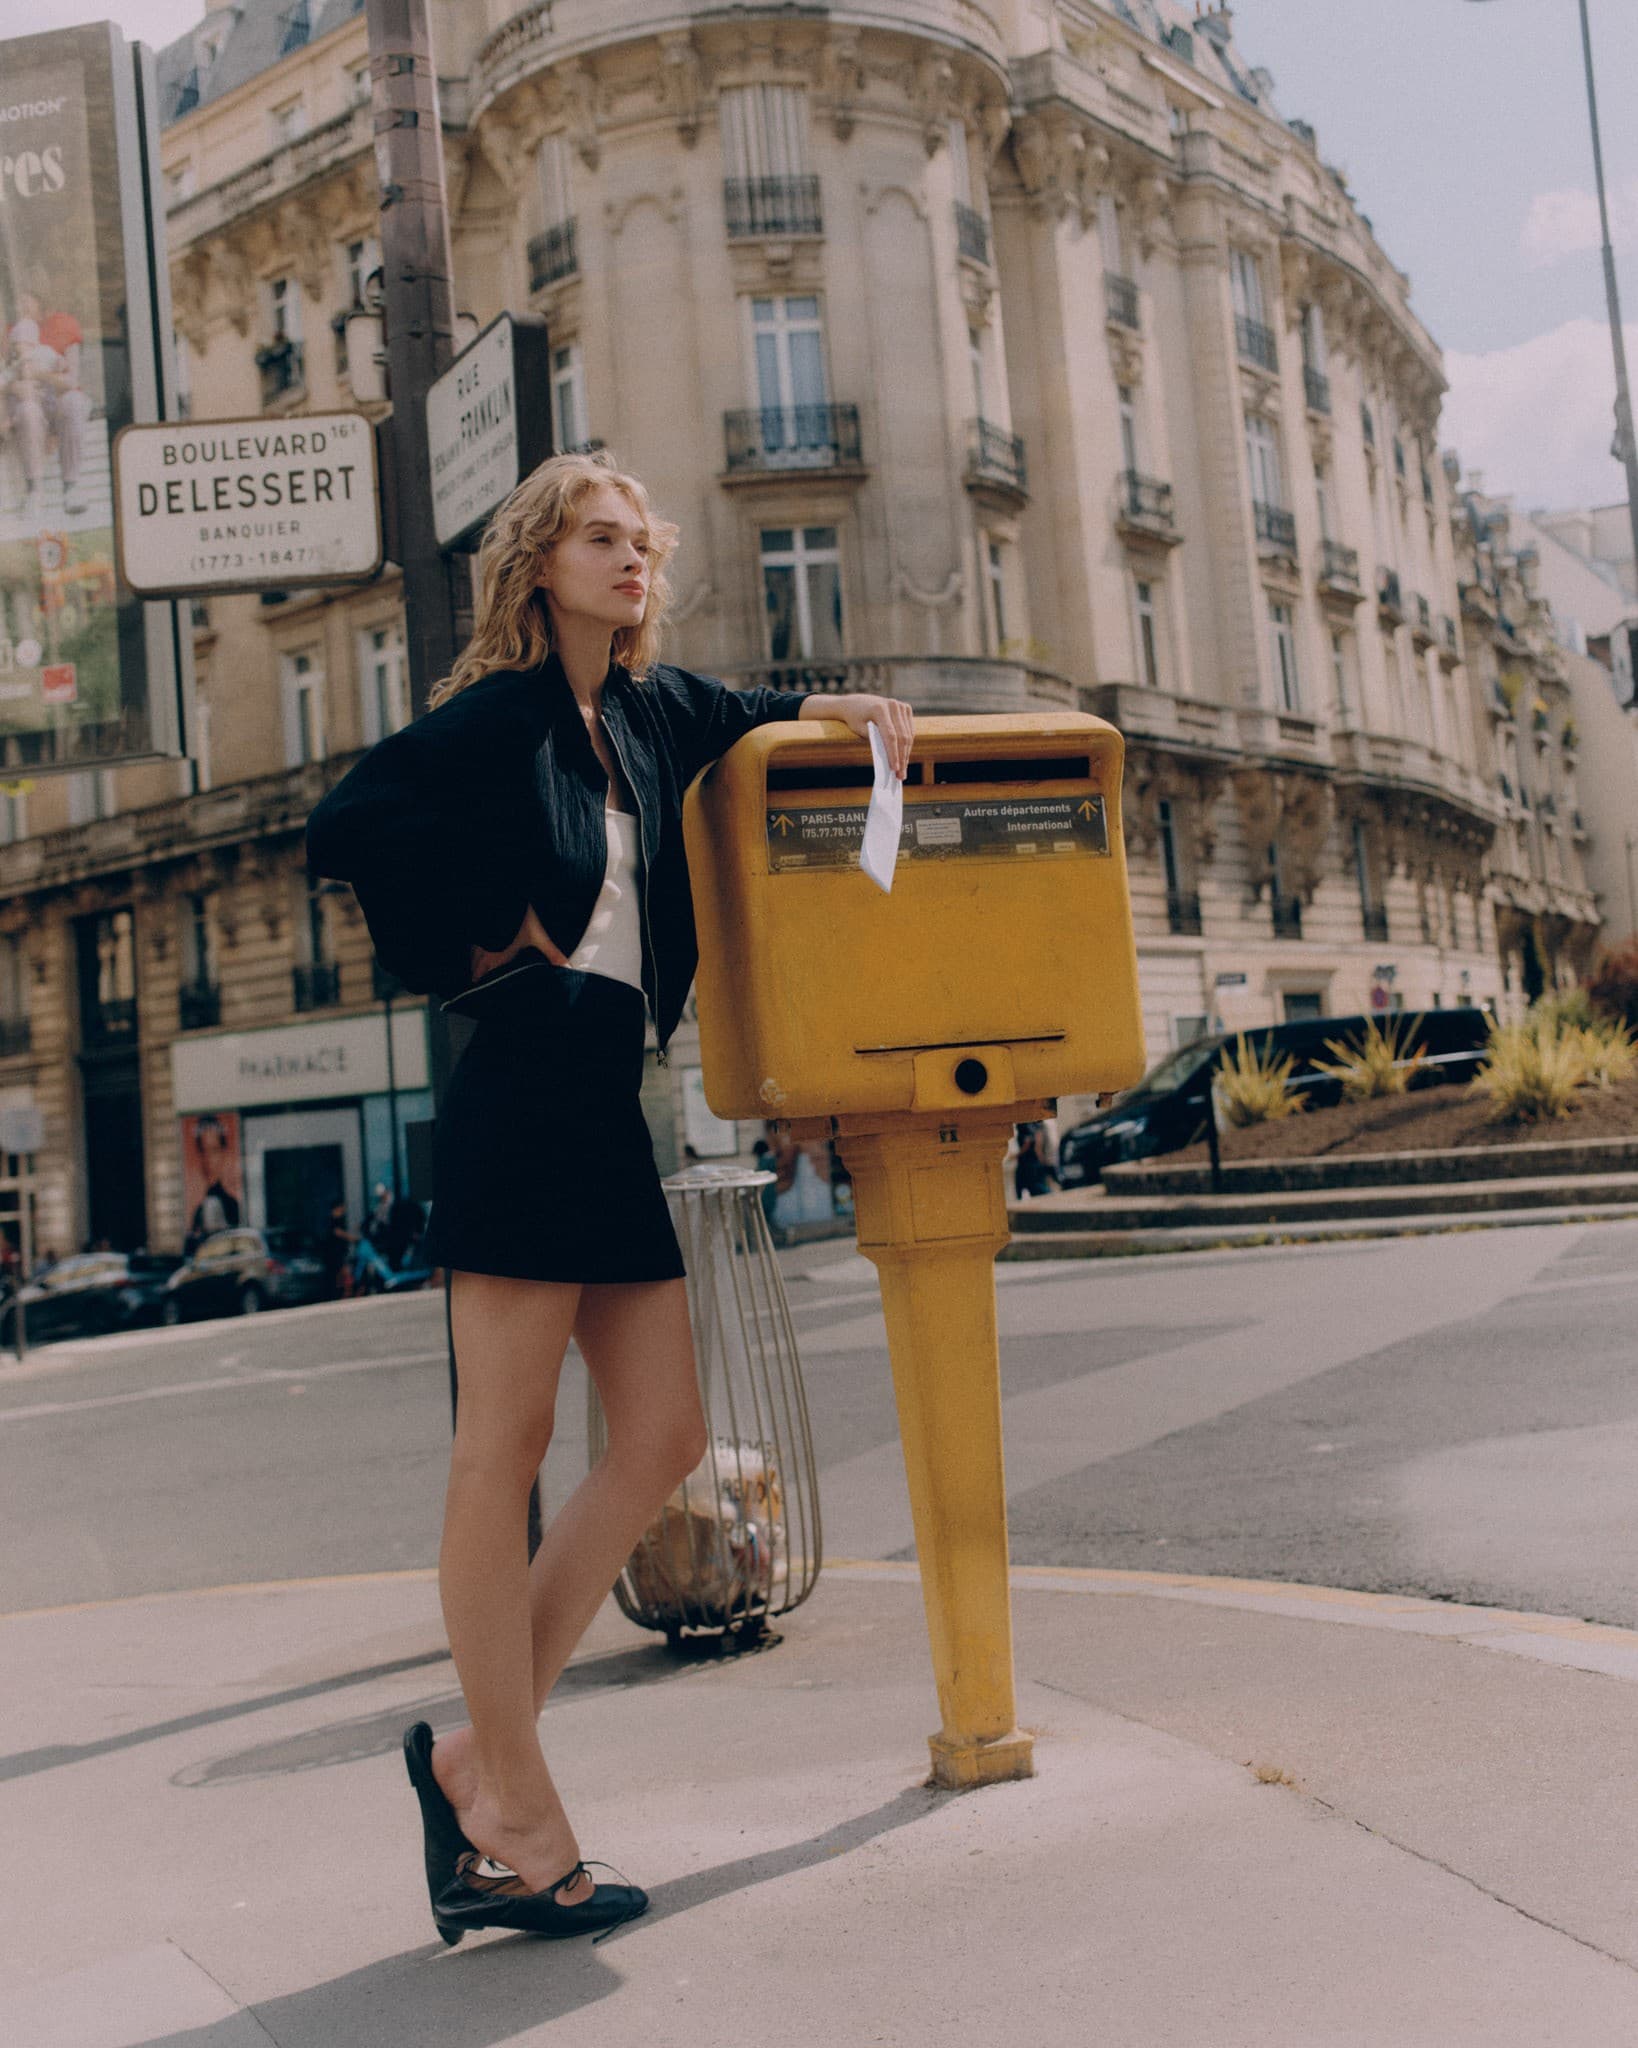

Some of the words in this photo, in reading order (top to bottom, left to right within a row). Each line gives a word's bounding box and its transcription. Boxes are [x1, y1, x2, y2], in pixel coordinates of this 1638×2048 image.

[457, 362, 479, 399] RUE
[163, 432, 327, 465] BOULEVARD
[138, 465, 355, 516] DELESSERT
[200, 520, 301, 542] BANQUIER
[801, 812, 867, 825] PARIS-BANL
[964, 807, 998, 817] Autres
[1000, 803, 1071, 816] départements
[802, 826, 865, 839] (75.77.78.91.9
[1007, 820, 1073, 832] International
